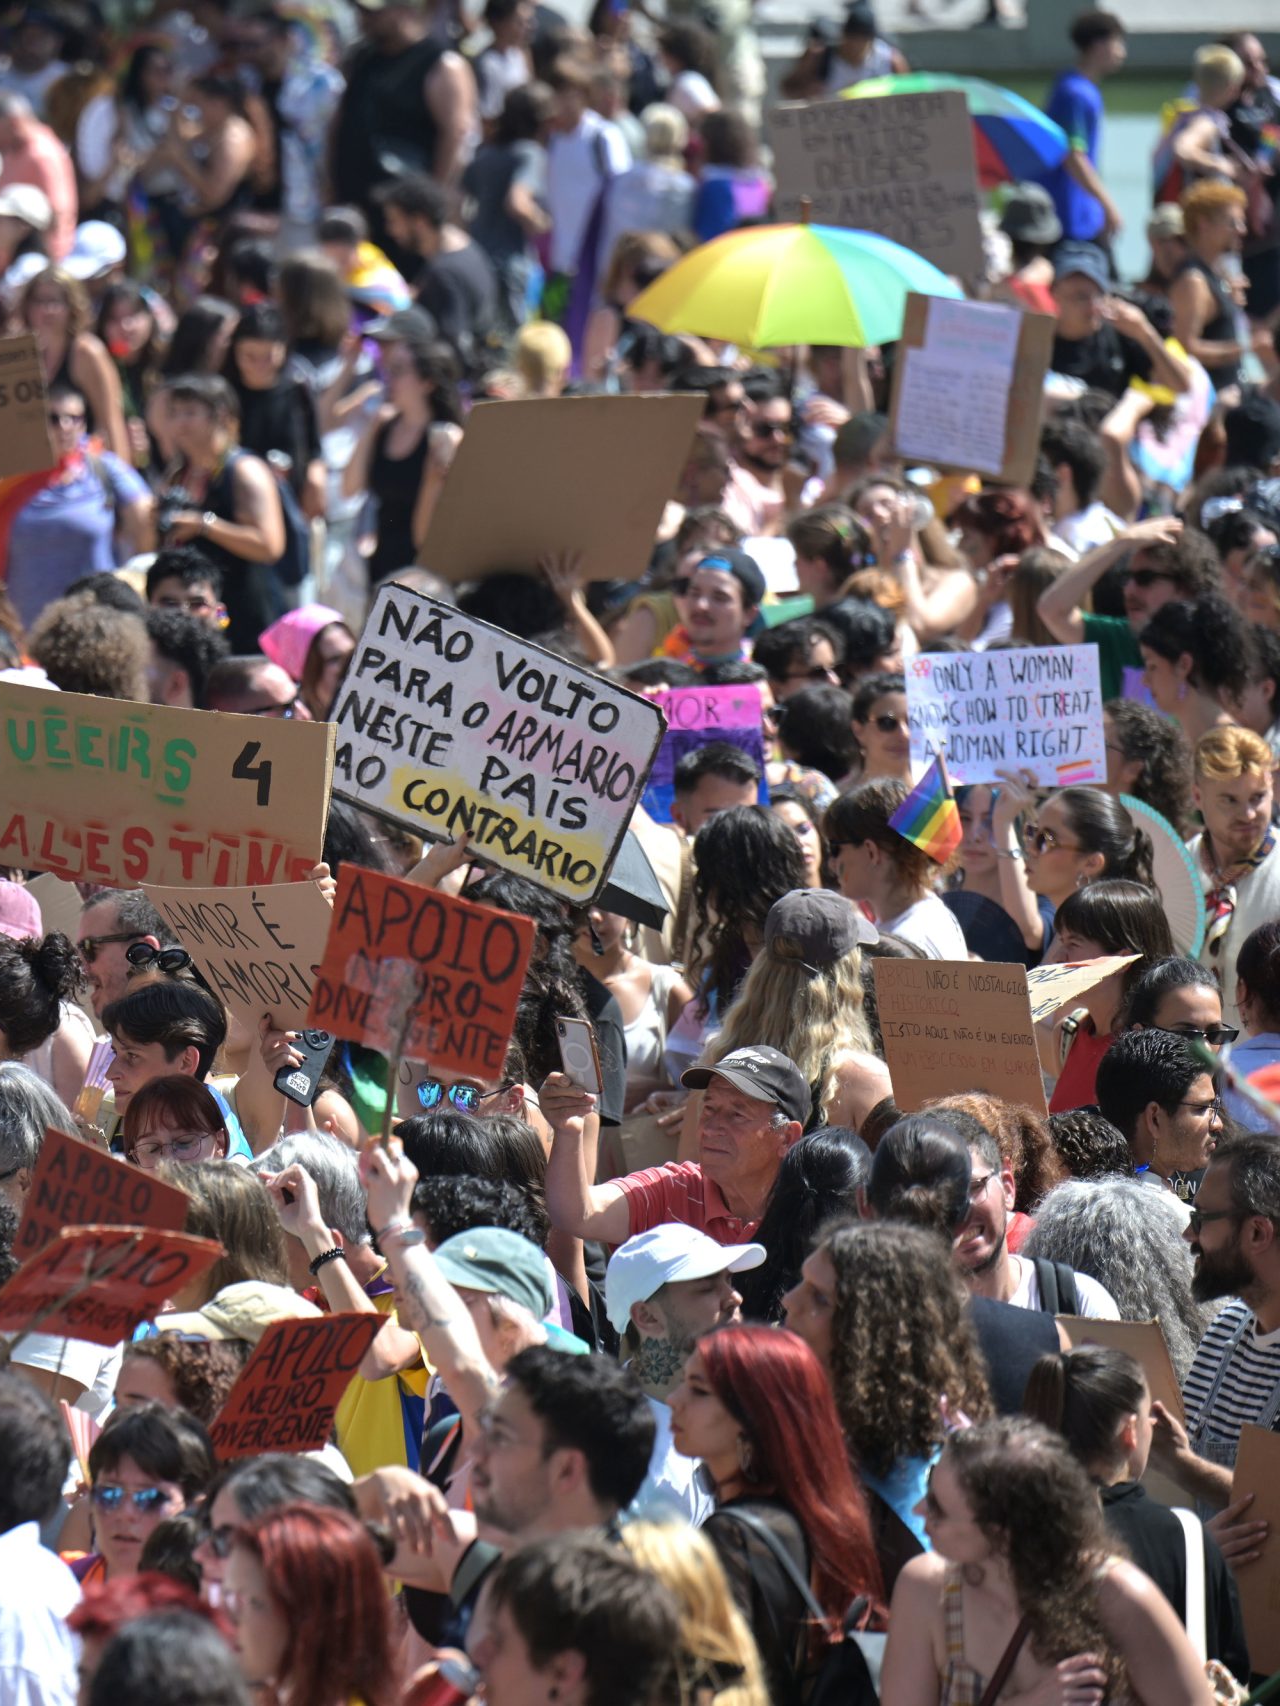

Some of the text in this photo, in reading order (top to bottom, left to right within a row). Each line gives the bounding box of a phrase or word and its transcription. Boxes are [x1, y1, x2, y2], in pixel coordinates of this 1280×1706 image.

[814, 156, 931, 191] DEUSES
[356, 647, 454, 717] PARA
[462, 701, 489, 729] O
[378, 599, 620, 734] NÃO VOLTO
[933, 653, 1074, 693] ONLY A WOMAN
[337, 690, 454, 768] NESTE
[909, 689, 1094, 728] KNOWS HOW TO TREAT
[924, 726, 1088, 765] A WOMAN RIGHT
[231, 740, 273, 807] 4
[335, 742, 597, 886] AO CONTRARIO
[162, 890, 296, 951] AMOR É
[337, 873, 521, 985] APOIO
[348, 946, 503, 1020] NRO-
[877, 963, 921, 989] ABRIL
[925, 970, 951, 990] NÃO
[953, 970, 960, 990] É
[883, 1021, 1034, 1046] ISTO AQUI NÃO É UM EVENTO
[747, 1063, 760, 1073] city
[981, 1057, 995, 1073] EM
[35, 1178, 144, 1226] NEU
[47, 1144, 153, 1213] APOIO
[241, 1317, 379, 1383] APOIO
[238, 1377, 325, 1416] NEURO
